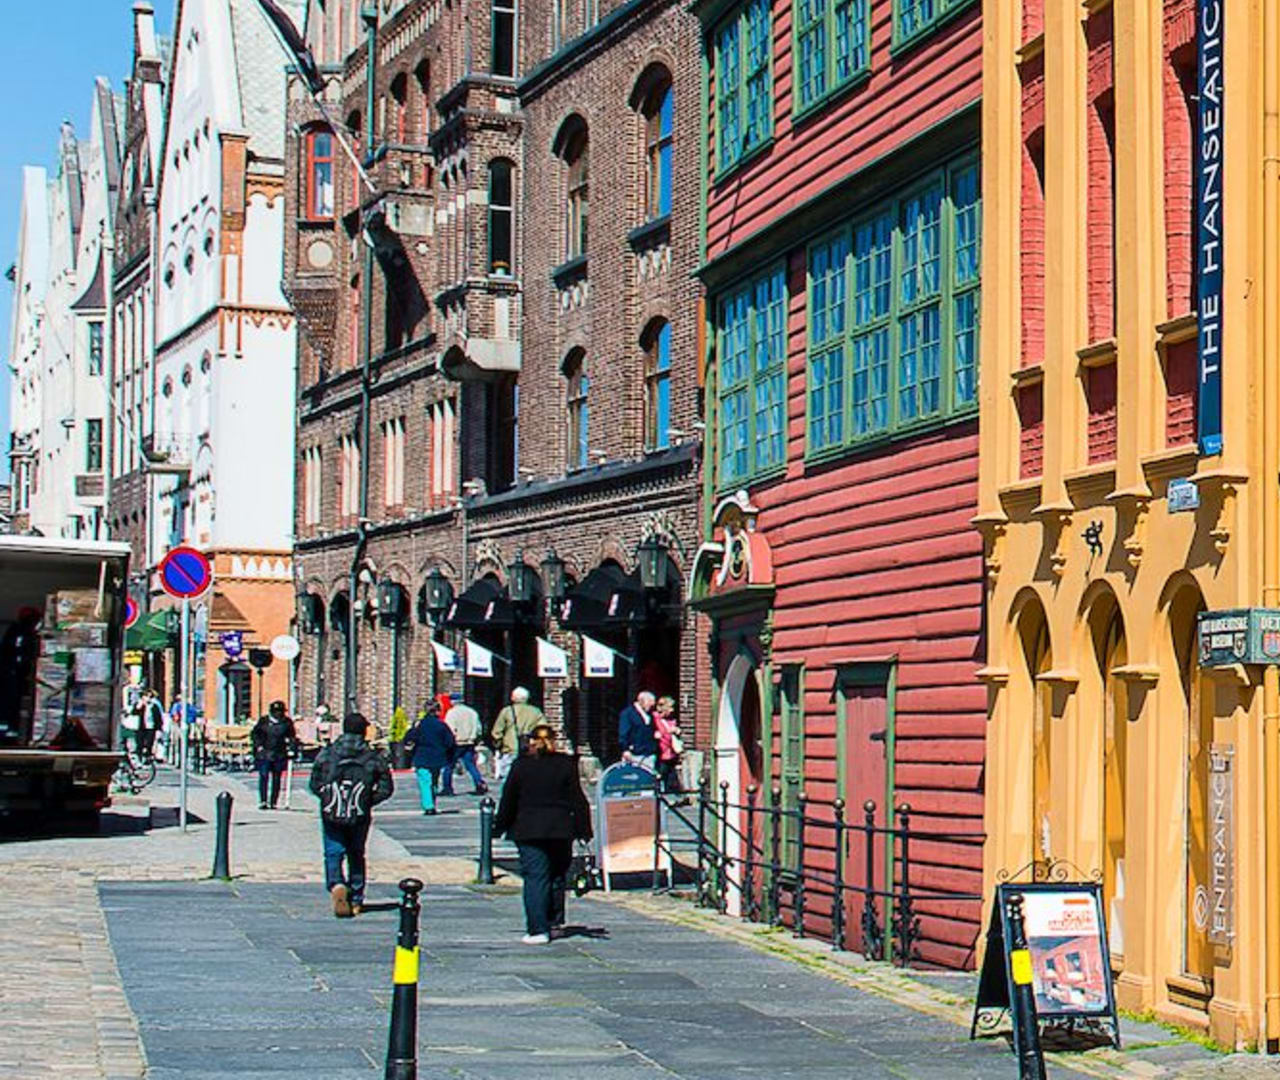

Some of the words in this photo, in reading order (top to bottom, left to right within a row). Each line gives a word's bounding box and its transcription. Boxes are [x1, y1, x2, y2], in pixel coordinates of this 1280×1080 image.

[1202, 0, 1221, 274] HANSEATIC
[1202, 294, 1219, 384] THE
[1260, 617, 1280, 630] DET
[1212, 756, 1227, 931] ENTRANCE
